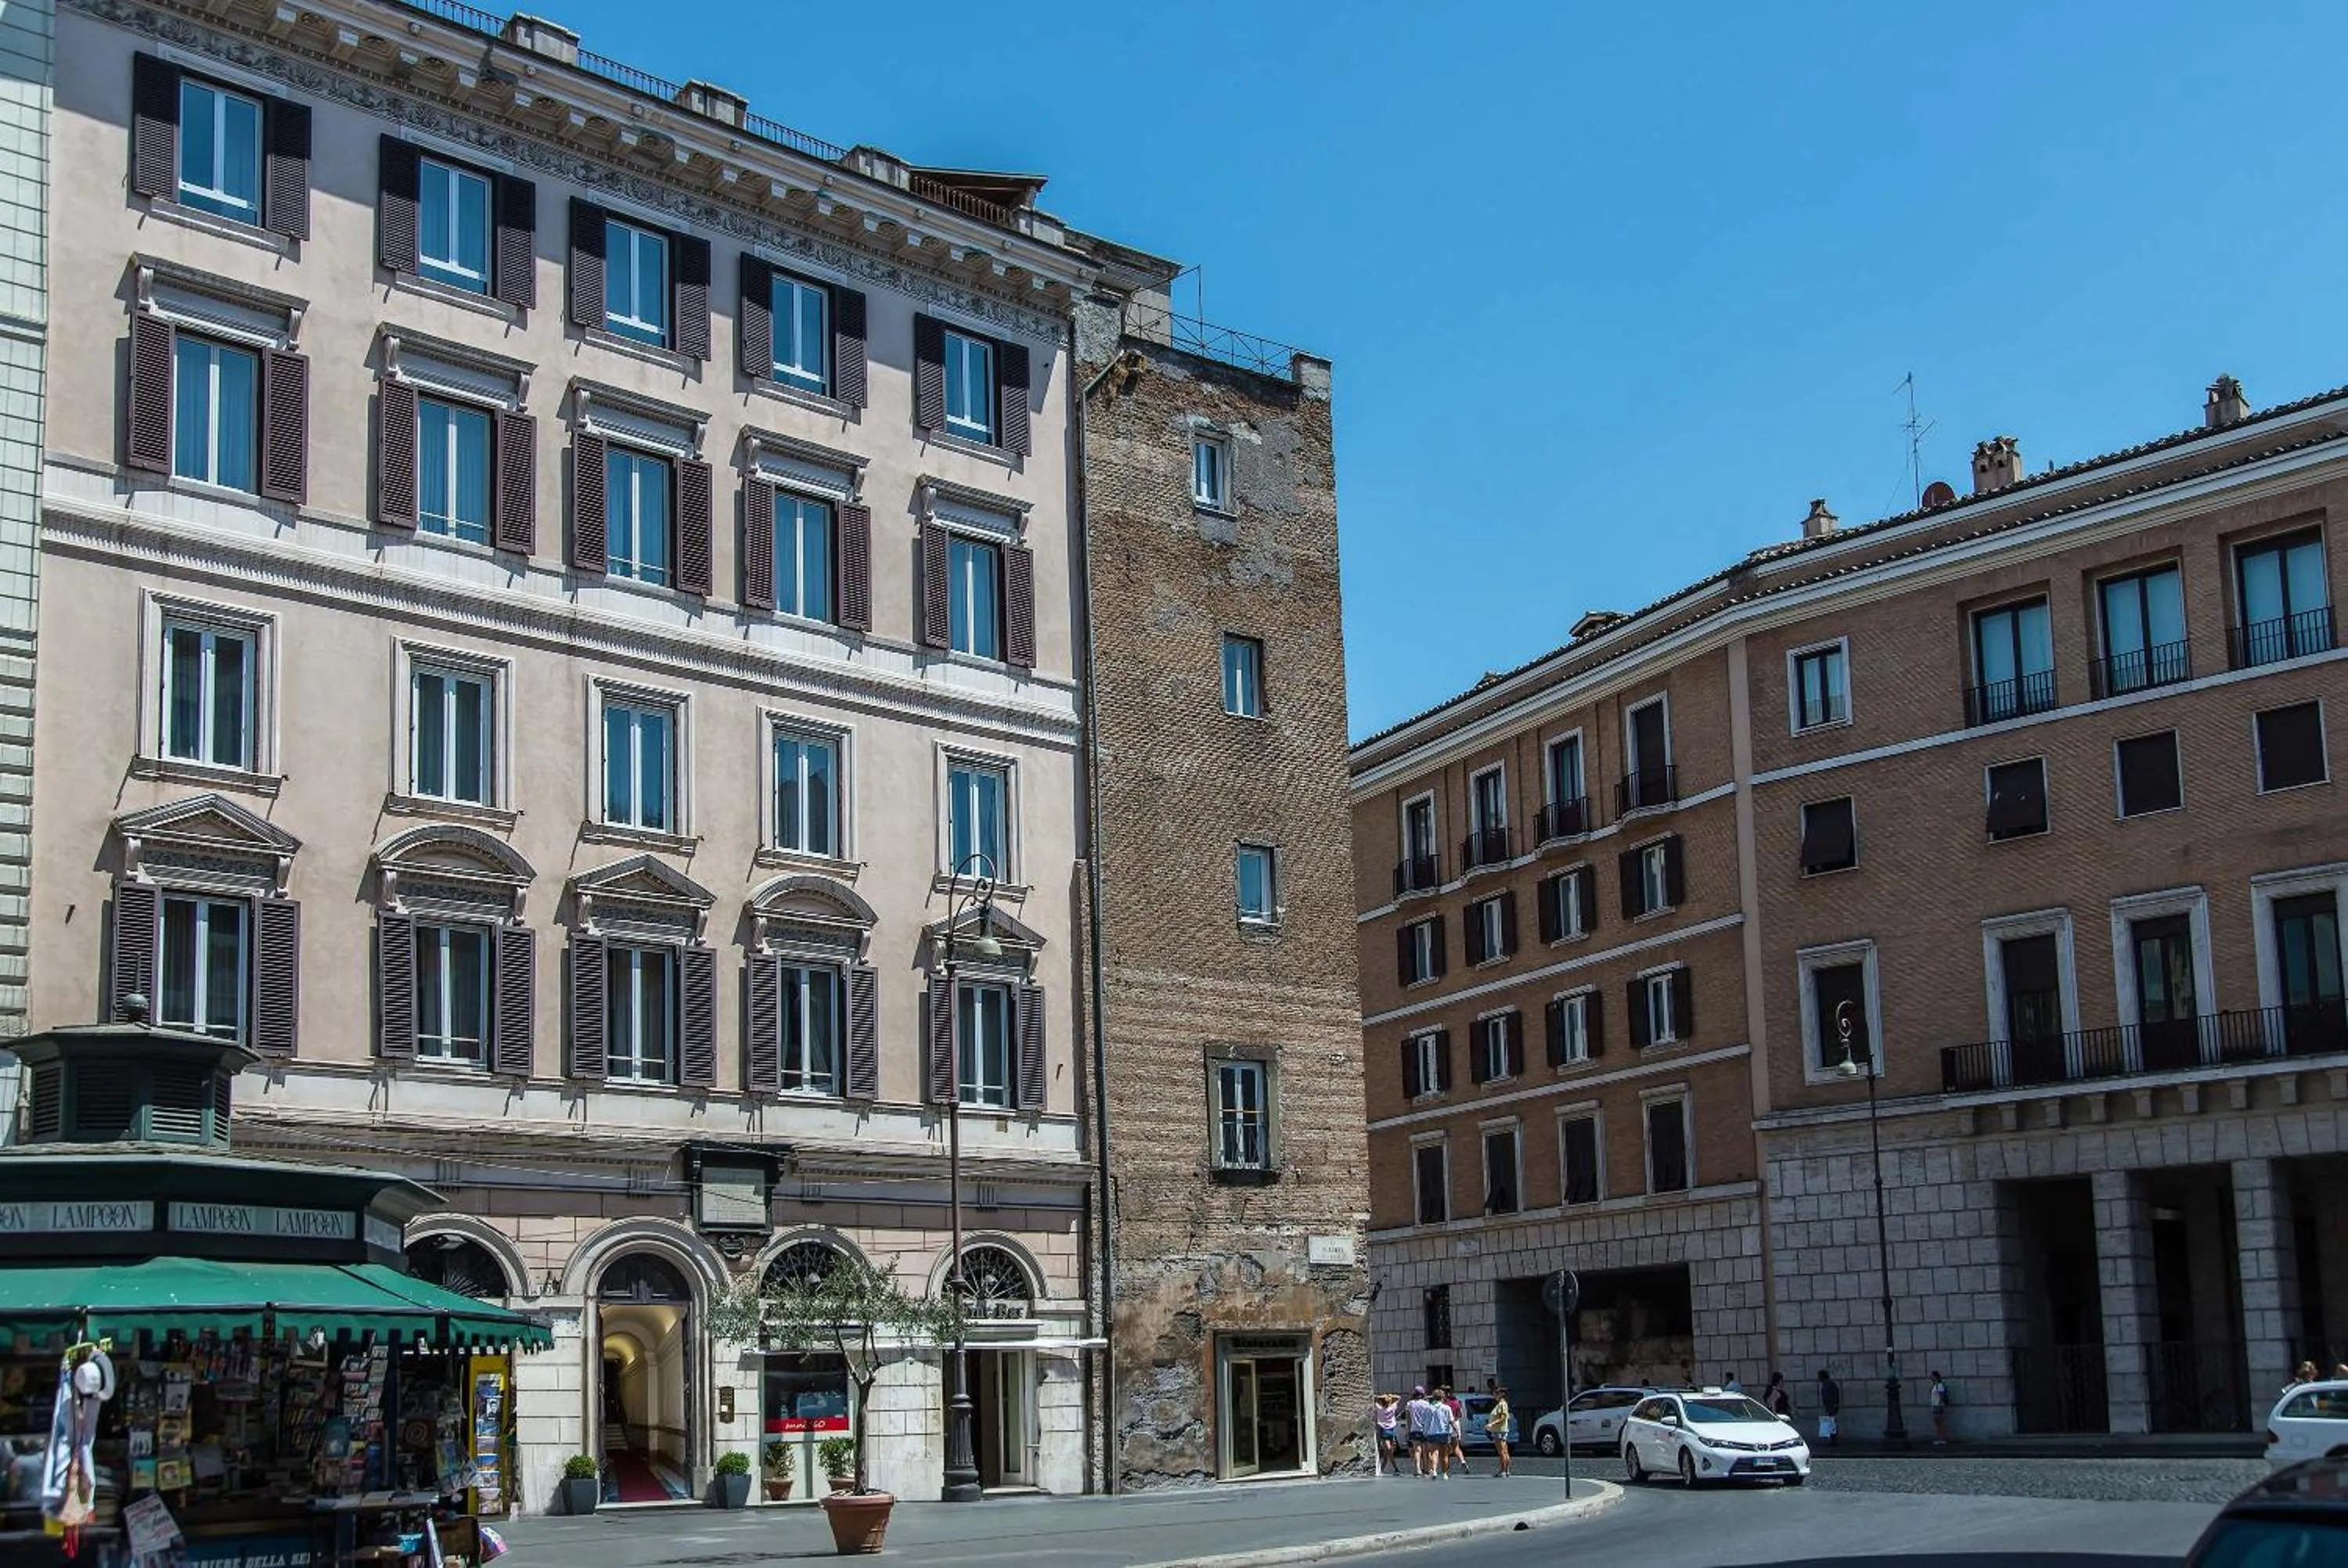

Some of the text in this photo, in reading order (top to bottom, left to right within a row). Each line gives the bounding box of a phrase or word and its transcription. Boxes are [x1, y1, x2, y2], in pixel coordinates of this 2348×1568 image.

[52, 1203, 137, 1228] LAMPOON
[178, 1205, 251, 1231] LAMPOON
[275, 1212, 344, 1235] LAMPOON
